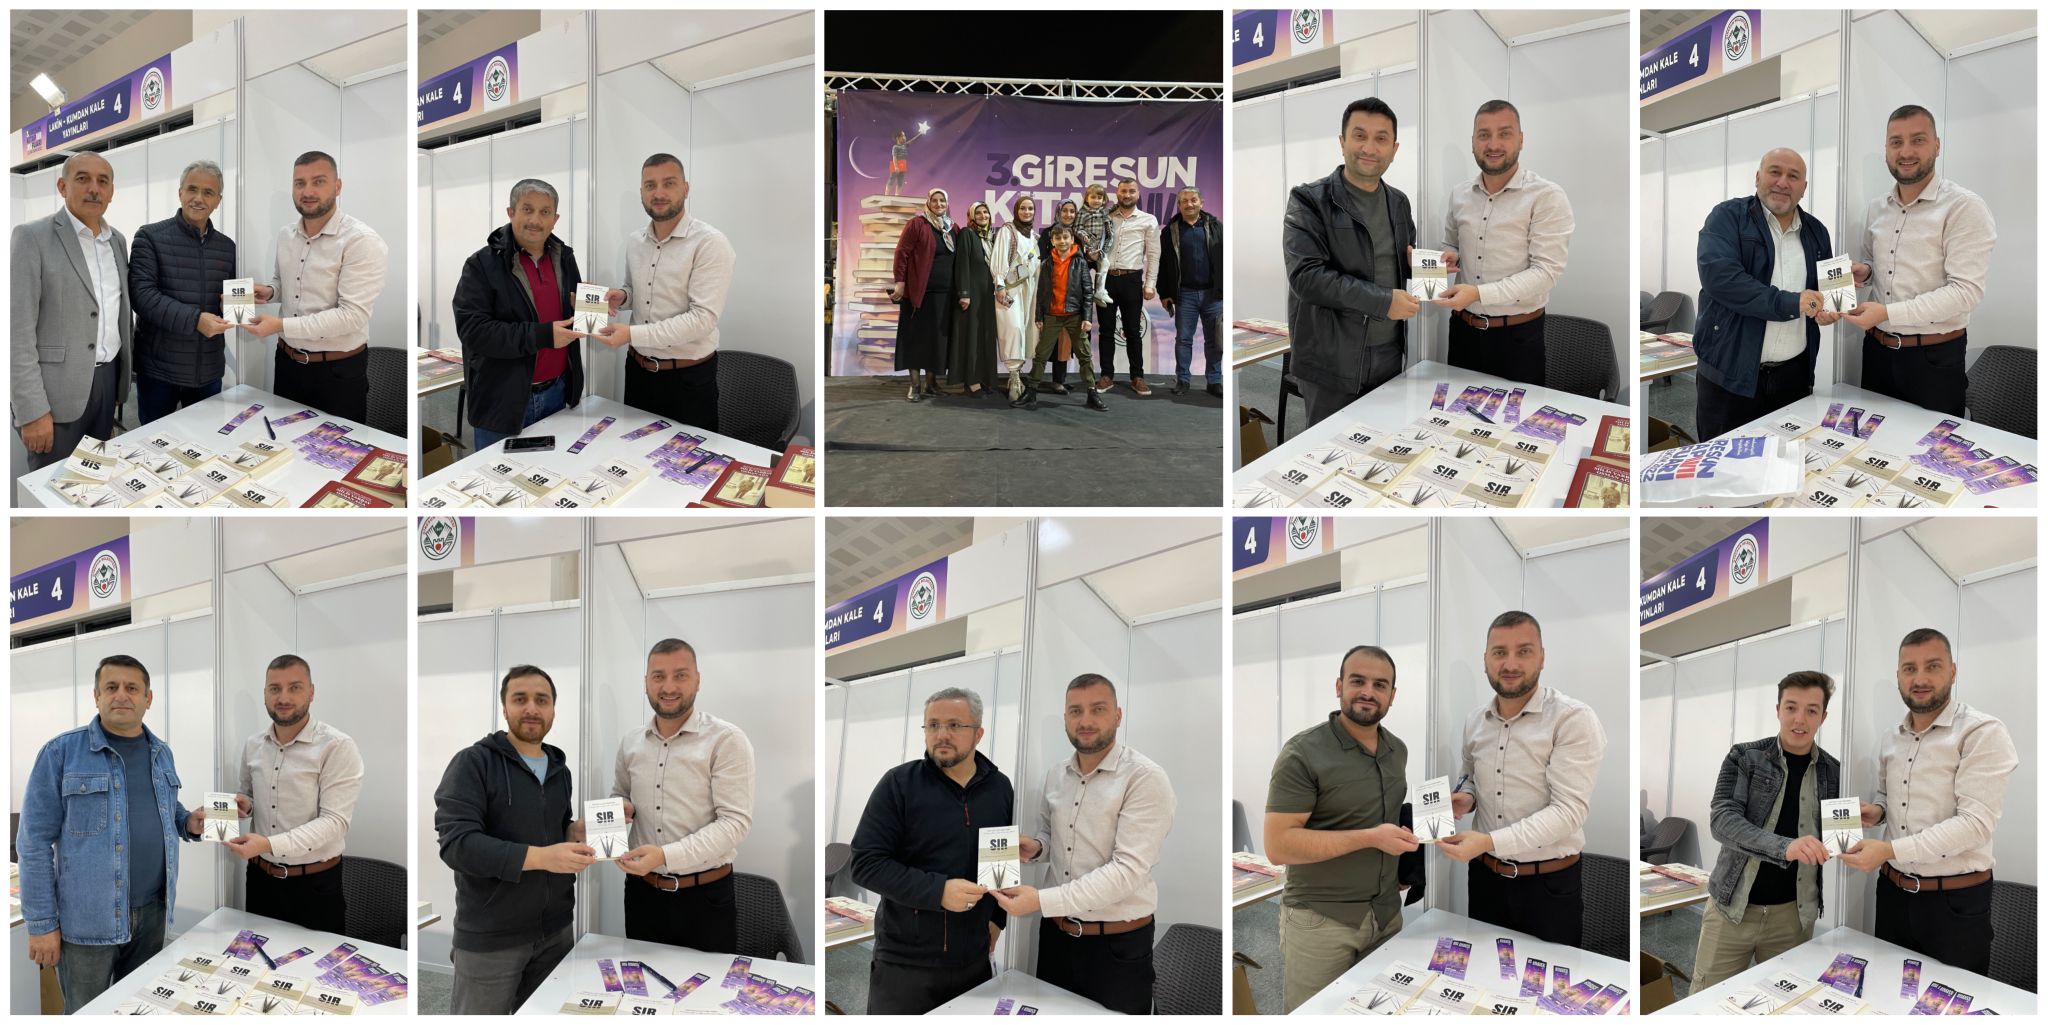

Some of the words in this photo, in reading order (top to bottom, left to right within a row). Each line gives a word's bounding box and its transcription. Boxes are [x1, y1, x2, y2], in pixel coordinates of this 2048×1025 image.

[1252, 22, 1264, 48] 4
[1660, 51, 1678, 70] KALE
[1688, 42, 1699, 68] 4
[425, 87, 443, 103] KALE
[453, 81, 462, 104] 4
[113, 93, 122, 114] 4
[66, 107, 89, 125] KUMDAN
[89, 99, 105, 115] KALE
[62, 120, 89, 138] YAYINLARI
[1421, 258, 1437, 269] SIR
[1827, 267, 1843, 280] SIR
[232, 287, 246, 297] SIR
[585, 293, 600, 304] SIR
[1429, 416, 1450, 427] SIR
[1780, 422, 1801, 432] SIR
[1348, 432, 1372, 445] SIR
[1470, 428, 1492, 439] SIR
[151, 438, 170, 448] SIR
[255, 443, 274, 452] SIR
[1514, 441, 1539, 454] SIR
[1821, 438, 1845, 450] SIR
[183, 448, 202, 460] SIR
[1388, 445, 1412, 456] SIR
[492, 463, 513, 475] SIR
[1864, 456, 1889, 470] SIR
[206, 470, 228, 483] SIR
[607, 465, 629, 478] SIR
[1281, 469, 1308, 485] SIR
[1432, 464, 1458, 480] SIR
[125, 478, 147, 492] SIR
[528, 473, 549, 487] SIR
[1914, 476, 1941, 491] SIR
[1484, 481, 1512, 497] SIR
[242, 490, 266, 504] SIR
[1323, 491, 1353, 508] SIR
[1809, 490, 1839, 508] SIR
[1244, 526, 1257, 554] 4
[1667, 574, 1686, 594] KALE
[1695, 566, 1706, 591] 4
[17, 582, 39, 600] KALE
[51, 577, 63, 601] 4
[843, 606, 863, 624] KALE
[873, 600, 884, 624] 4
[1422, 791, 1440, 805] SIR
[213, 801, 228, 812] SIR
[596, 810, 614, 823] SIR
[1832, 808, 1850, 820] SIR
[990, 838, 1008, 850] SIR
[193, 957, 213, 967] SIR
[230, 966, 251, 977] SIR
[271, 979, 294, 991] SIR
[1390, 972, 1414, 986] SIR
[1774, 979, 1798, 993] SIR
[152, 986, 175, 999] SIR
[318, 993, 342, 1006] SIR
[1440, 988, 1465, 1002] SIR
[193, 1000, 217, 1013] SIR
[580, 998, 604, 1009] SIR
[1818, 999, 1845, 1014] SIR
